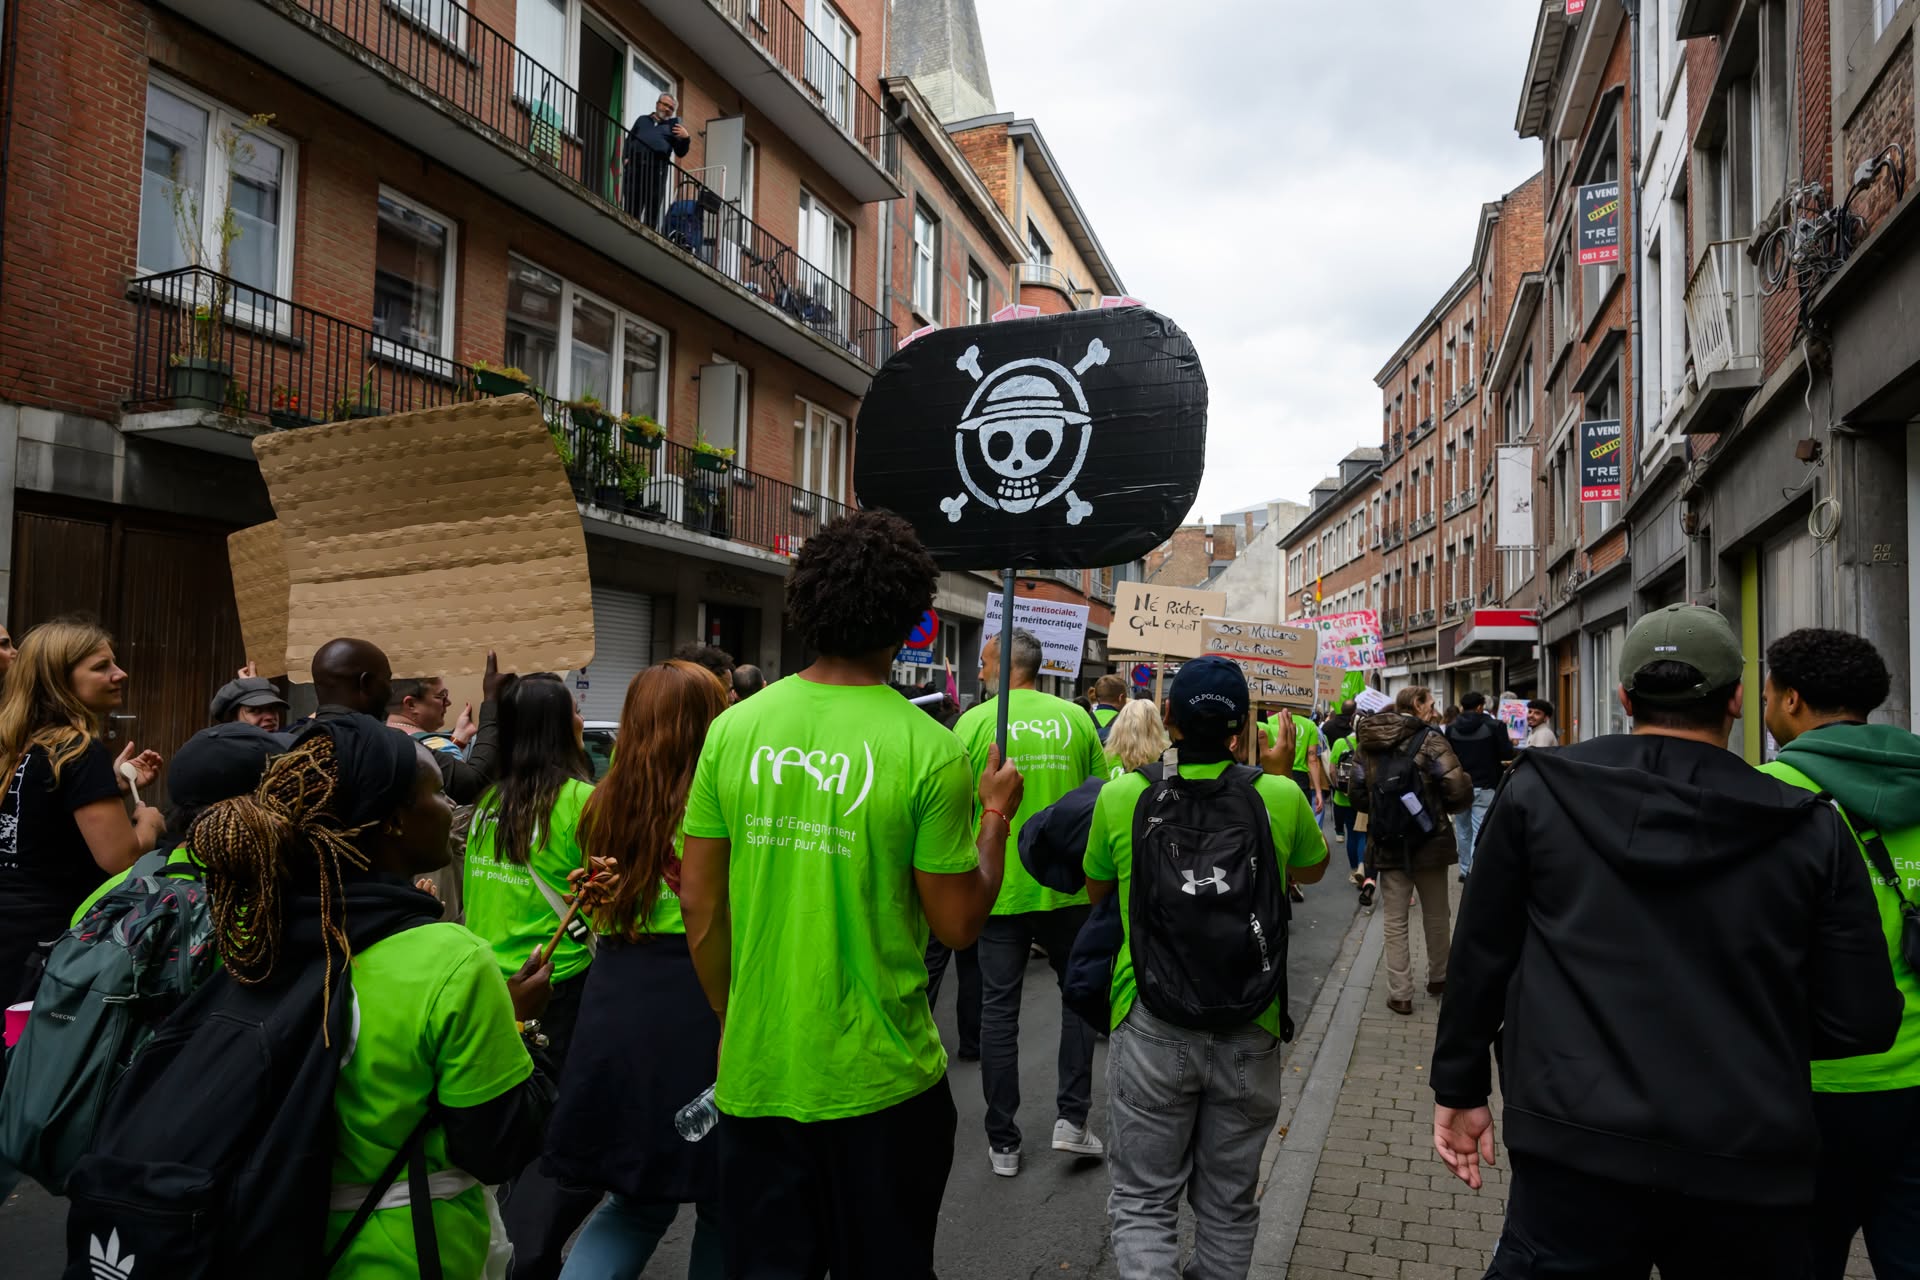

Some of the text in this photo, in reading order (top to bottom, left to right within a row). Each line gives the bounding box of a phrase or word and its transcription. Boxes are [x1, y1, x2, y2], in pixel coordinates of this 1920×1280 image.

[1586, 191, 1594, 200] A
[1585, 227, 1617, 239] TRE
[1582, 251, 1597, 260] 081
[1600, 250, 1610, 258] 22
[1588, 427, 1595, 437] A
[1586, 466, 1620, 477] TRE
[1584, 490, 1599, 498] 081
[1601, 489, 1612, 497] 22
[1031, 605, 1079, 618] antisociales,
[986, 611, 1083, 631] discrs méritocratique
